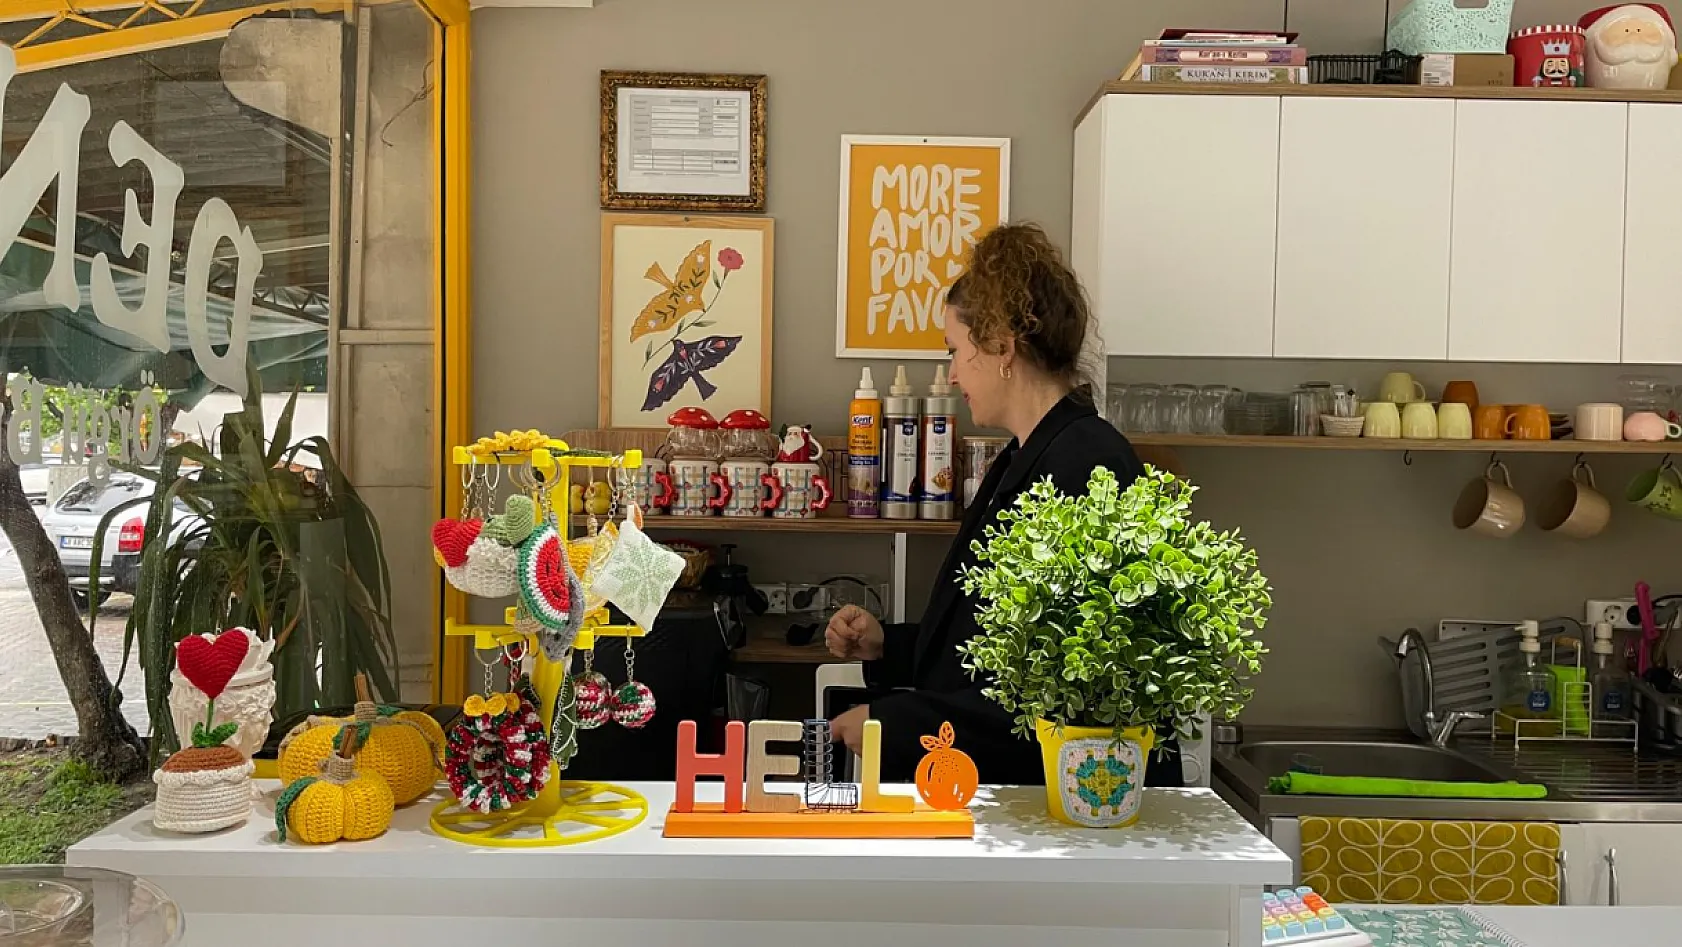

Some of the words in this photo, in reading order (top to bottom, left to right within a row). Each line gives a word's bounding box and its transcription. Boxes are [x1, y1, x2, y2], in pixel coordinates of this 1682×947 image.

[872, 164, 982, 214] MORE
[869, 208, 982, 257] AMOR
[871, 247, 940, 294] POR
[867, 286, 951, 335] FAVO
